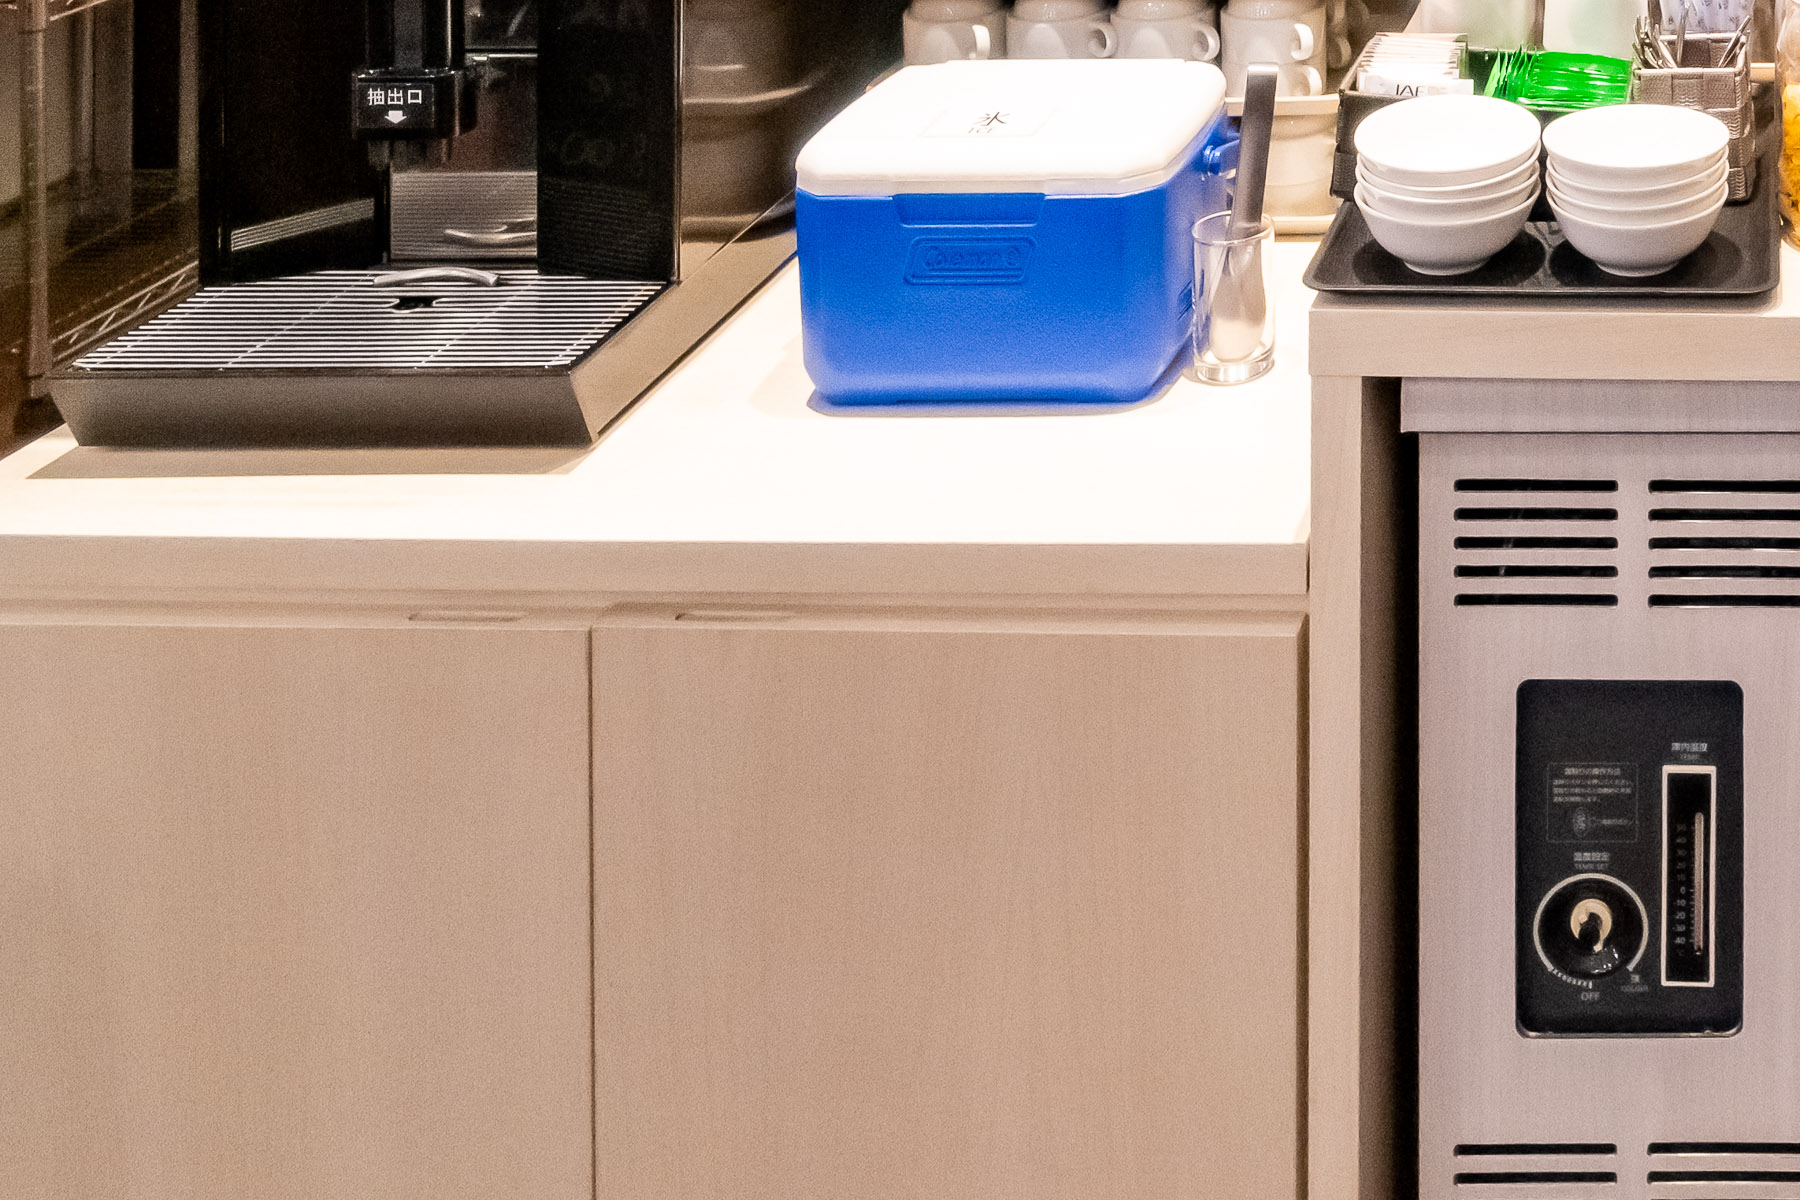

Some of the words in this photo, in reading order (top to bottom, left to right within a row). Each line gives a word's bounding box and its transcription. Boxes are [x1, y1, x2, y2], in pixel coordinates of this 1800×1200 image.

[367, 87, 423, 106] 抽出口
[973, 111, 1010, 127] 氷
